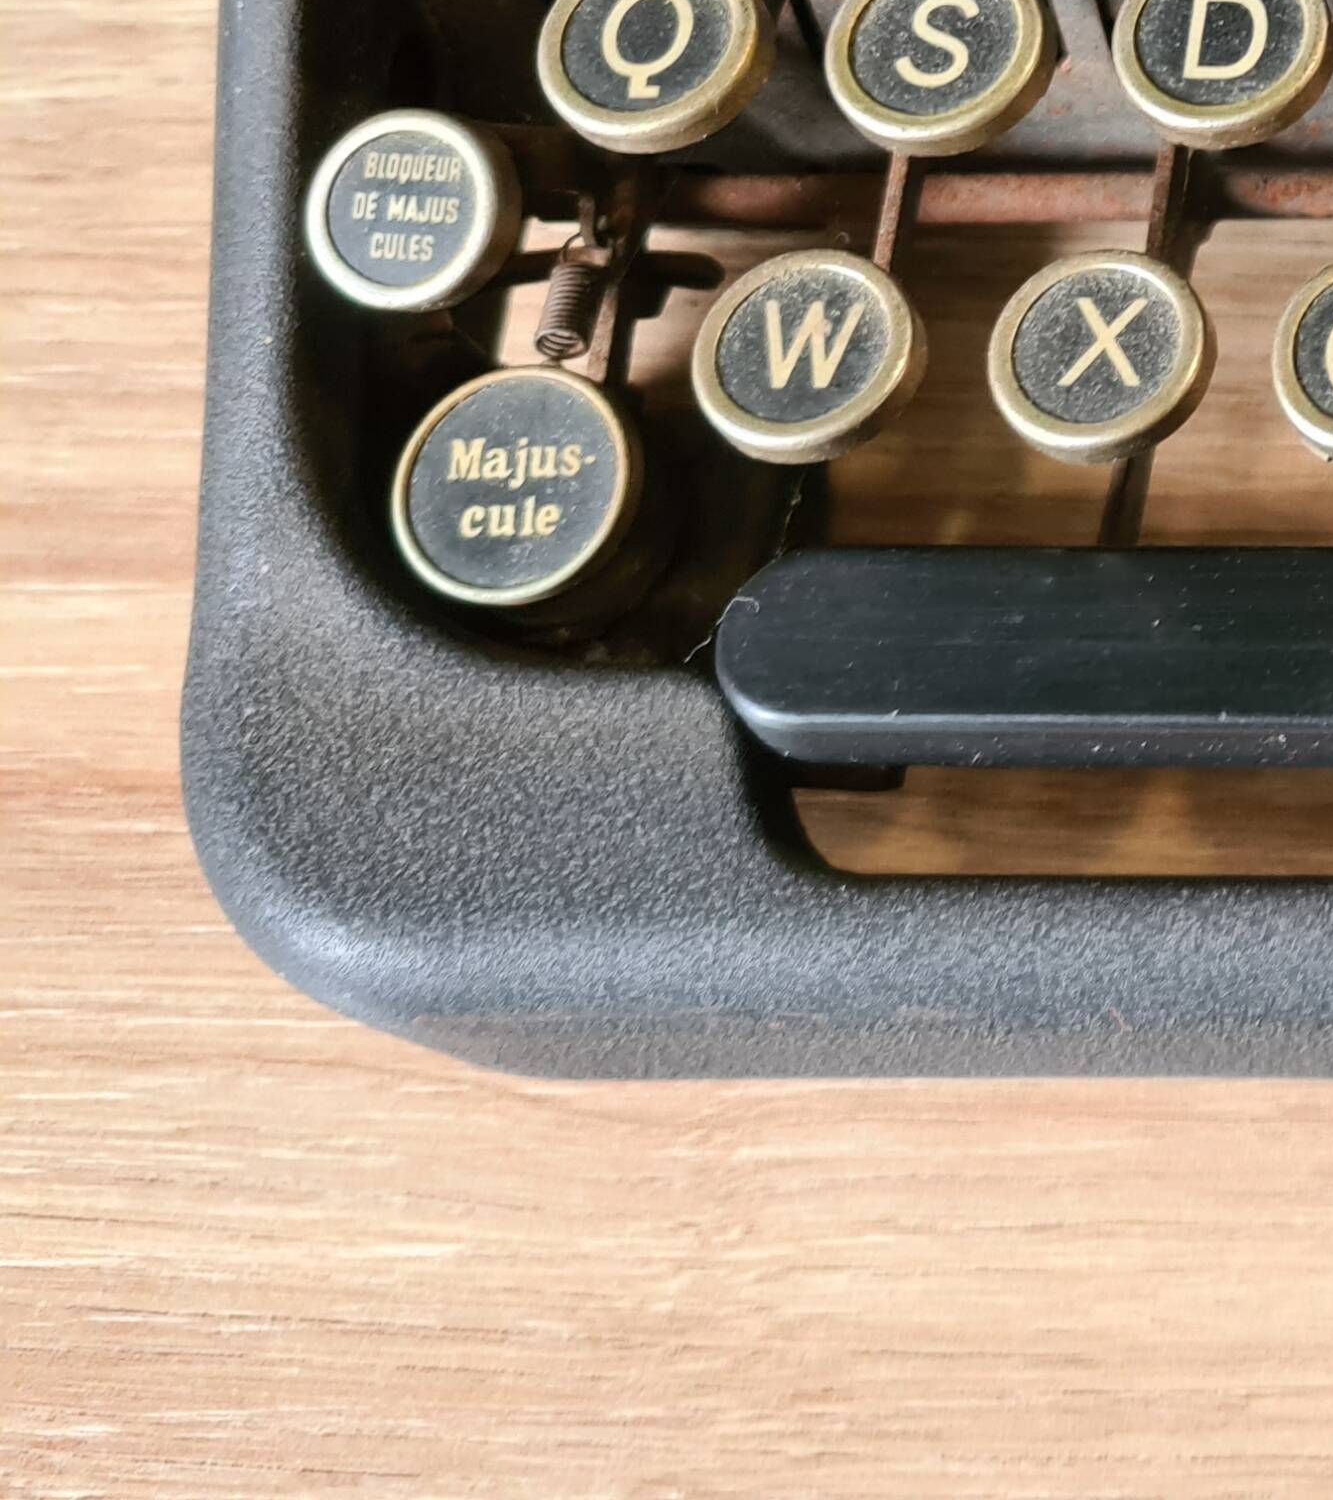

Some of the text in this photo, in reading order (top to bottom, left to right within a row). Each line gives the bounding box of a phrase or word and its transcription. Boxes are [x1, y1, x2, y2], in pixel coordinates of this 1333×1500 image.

[364, 151, 463, 184] BLOQUEUR
[352, 192, 460, 223] DE MAJUS
[370, 233, 434, 261] CULES
[766, 300, 866, 389] W
[1057, 297, 1149, 387] X
[459, 495, 563, 538] cule
